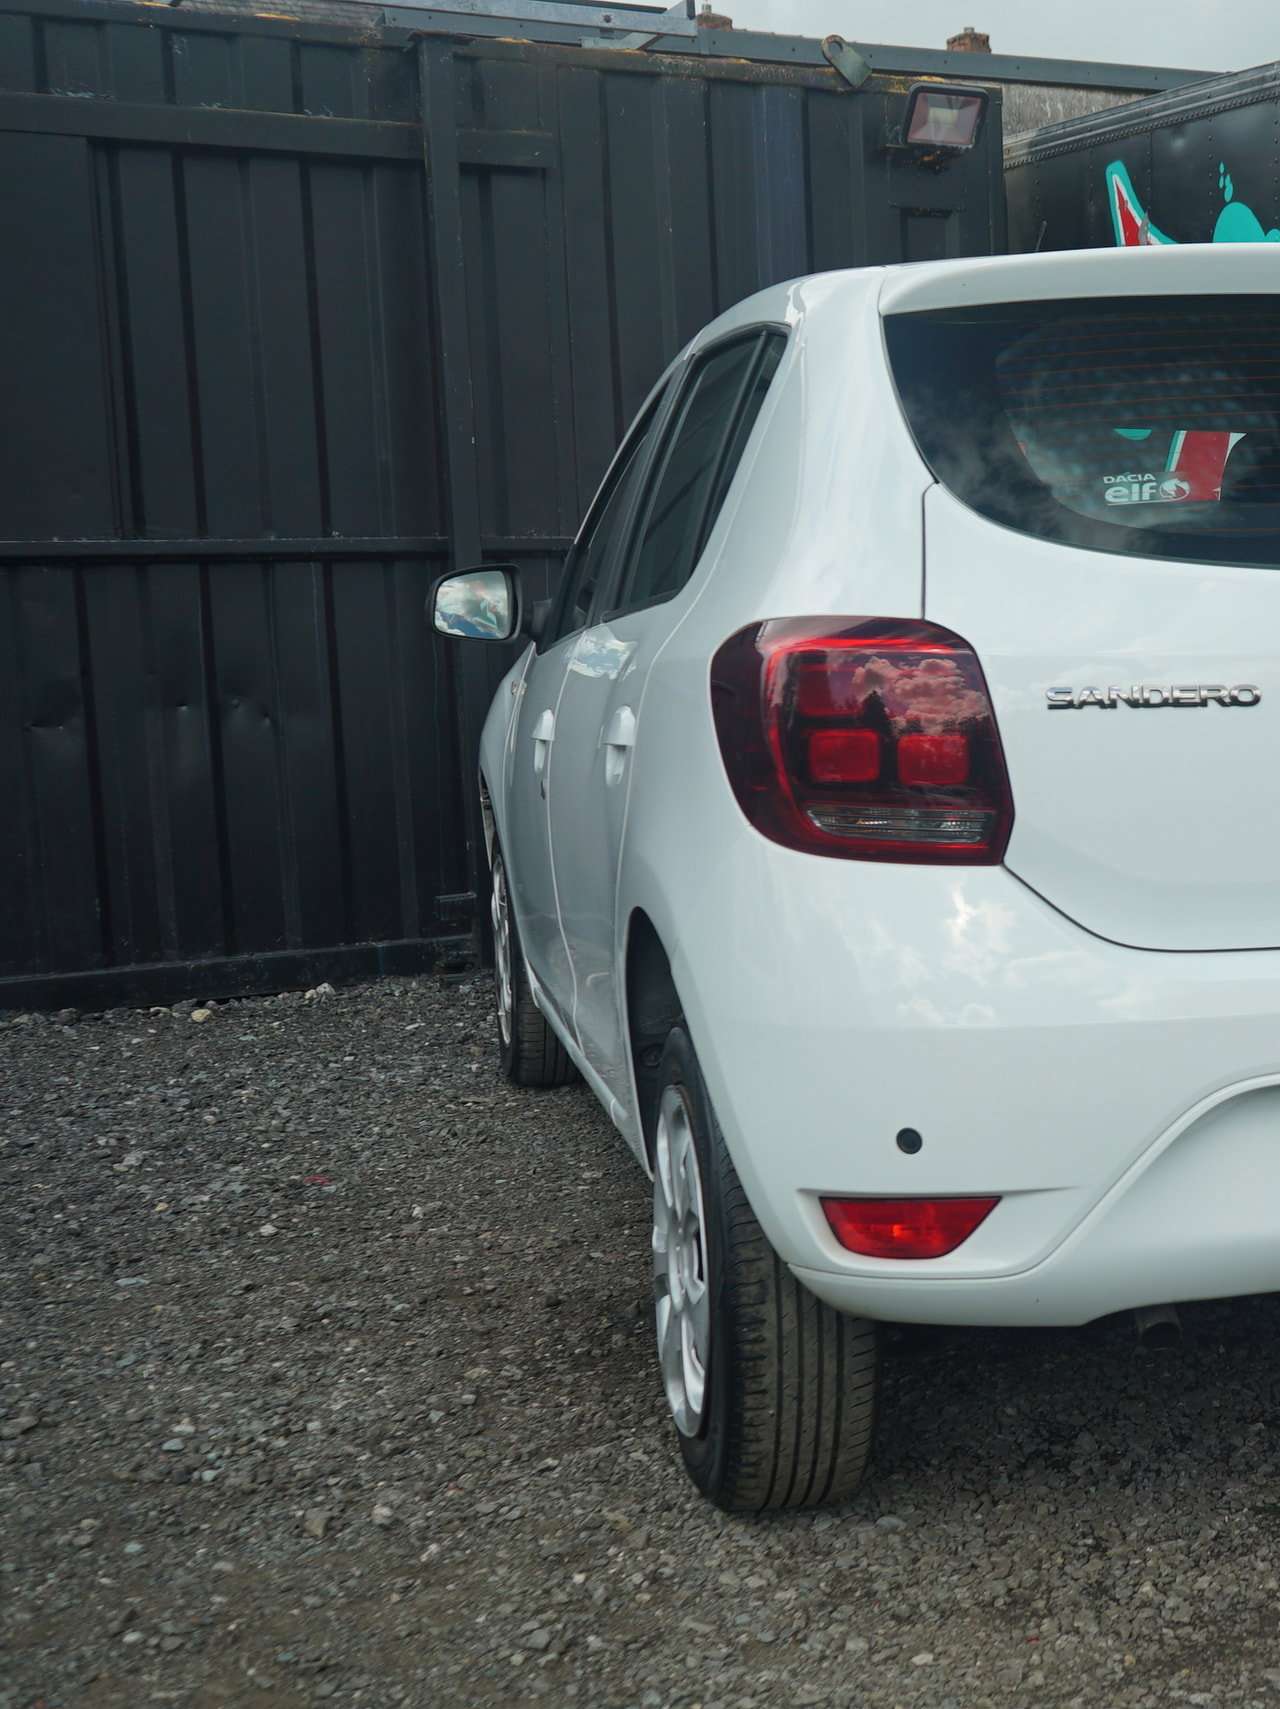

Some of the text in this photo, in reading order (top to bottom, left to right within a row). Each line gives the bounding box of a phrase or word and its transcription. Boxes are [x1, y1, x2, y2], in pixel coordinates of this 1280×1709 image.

[1103, 473, 1156, 484] DACIA
[1104, 482, 1157, 502] elf
[1046, 685, 1262, 709] SANDERO
